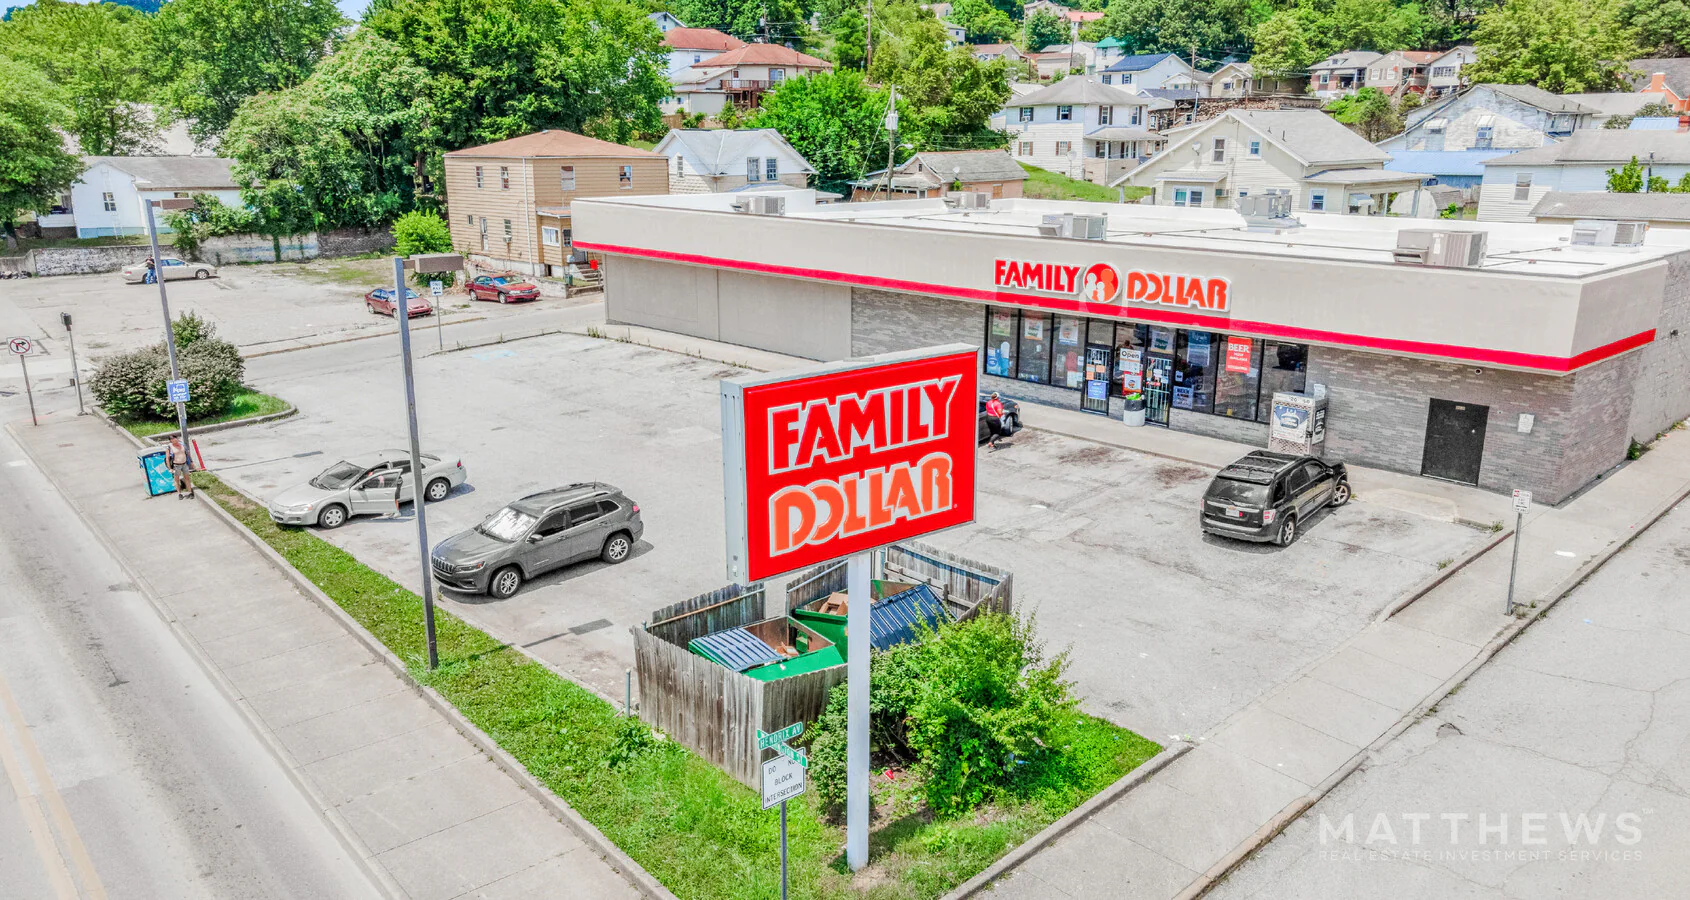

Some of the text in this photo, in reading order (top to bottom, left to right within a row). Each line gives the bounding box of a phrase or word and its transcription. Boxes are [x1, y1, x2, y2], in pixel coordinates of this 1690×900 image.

[994, 259, 1229, 310] FAMILY DOLLAR
[1121, 350, 1140, 359] Open
[1228, 343, 1250, 353] BEER
[770, 377, 960, 472] FAMILY
[771, 454, 952, 555] DOLLAR
[760, 724, 801, 749] HENDRIX AV
[768, 765, 776, 775] DO
[774, 772, 793, 786] BLOCK
[765, 782, 803, 803] INTERSECTION
